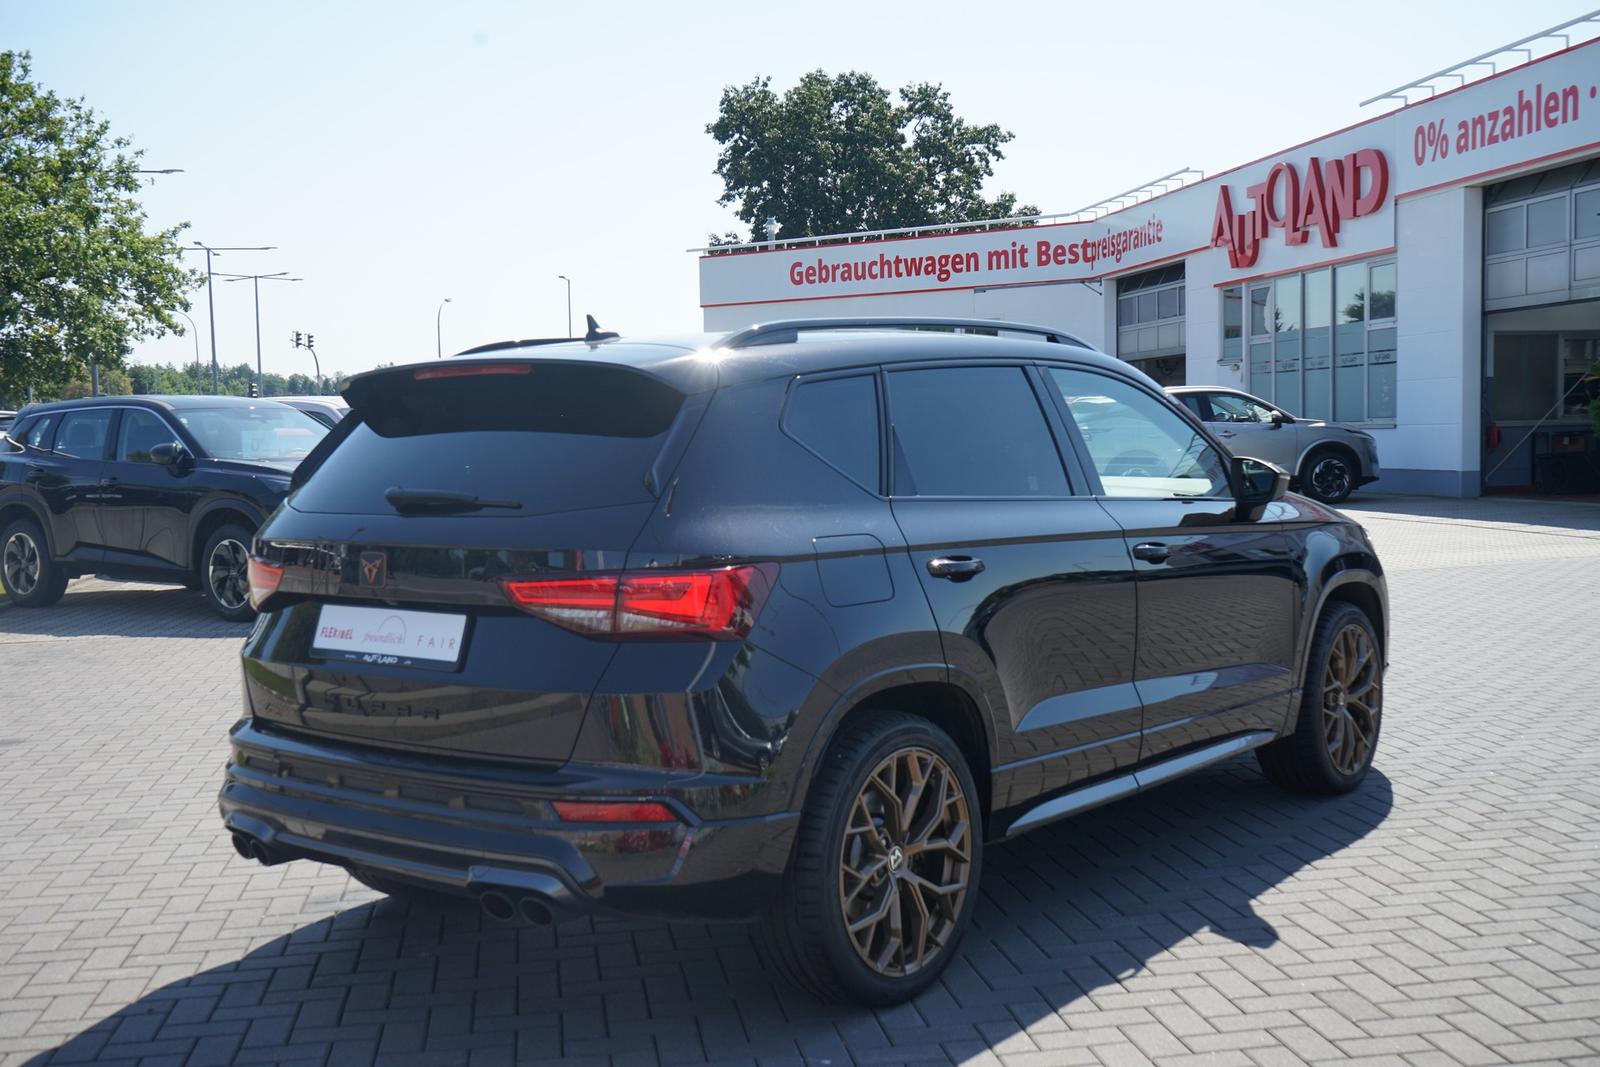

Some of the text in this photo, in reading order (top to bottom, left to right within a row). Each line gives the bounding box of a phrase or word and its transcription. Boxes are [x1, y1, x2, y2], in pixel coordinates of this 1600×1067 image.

[1414, 83, 1579, 166] 0% anzahlen
[1210, 148, 1389, 268] AUTOLAND
[789, 213, 1163, 286] Gebrauchtwagen mit Bestpreisgarantie
[320, 626, 353, 640] FLEXIBEL
